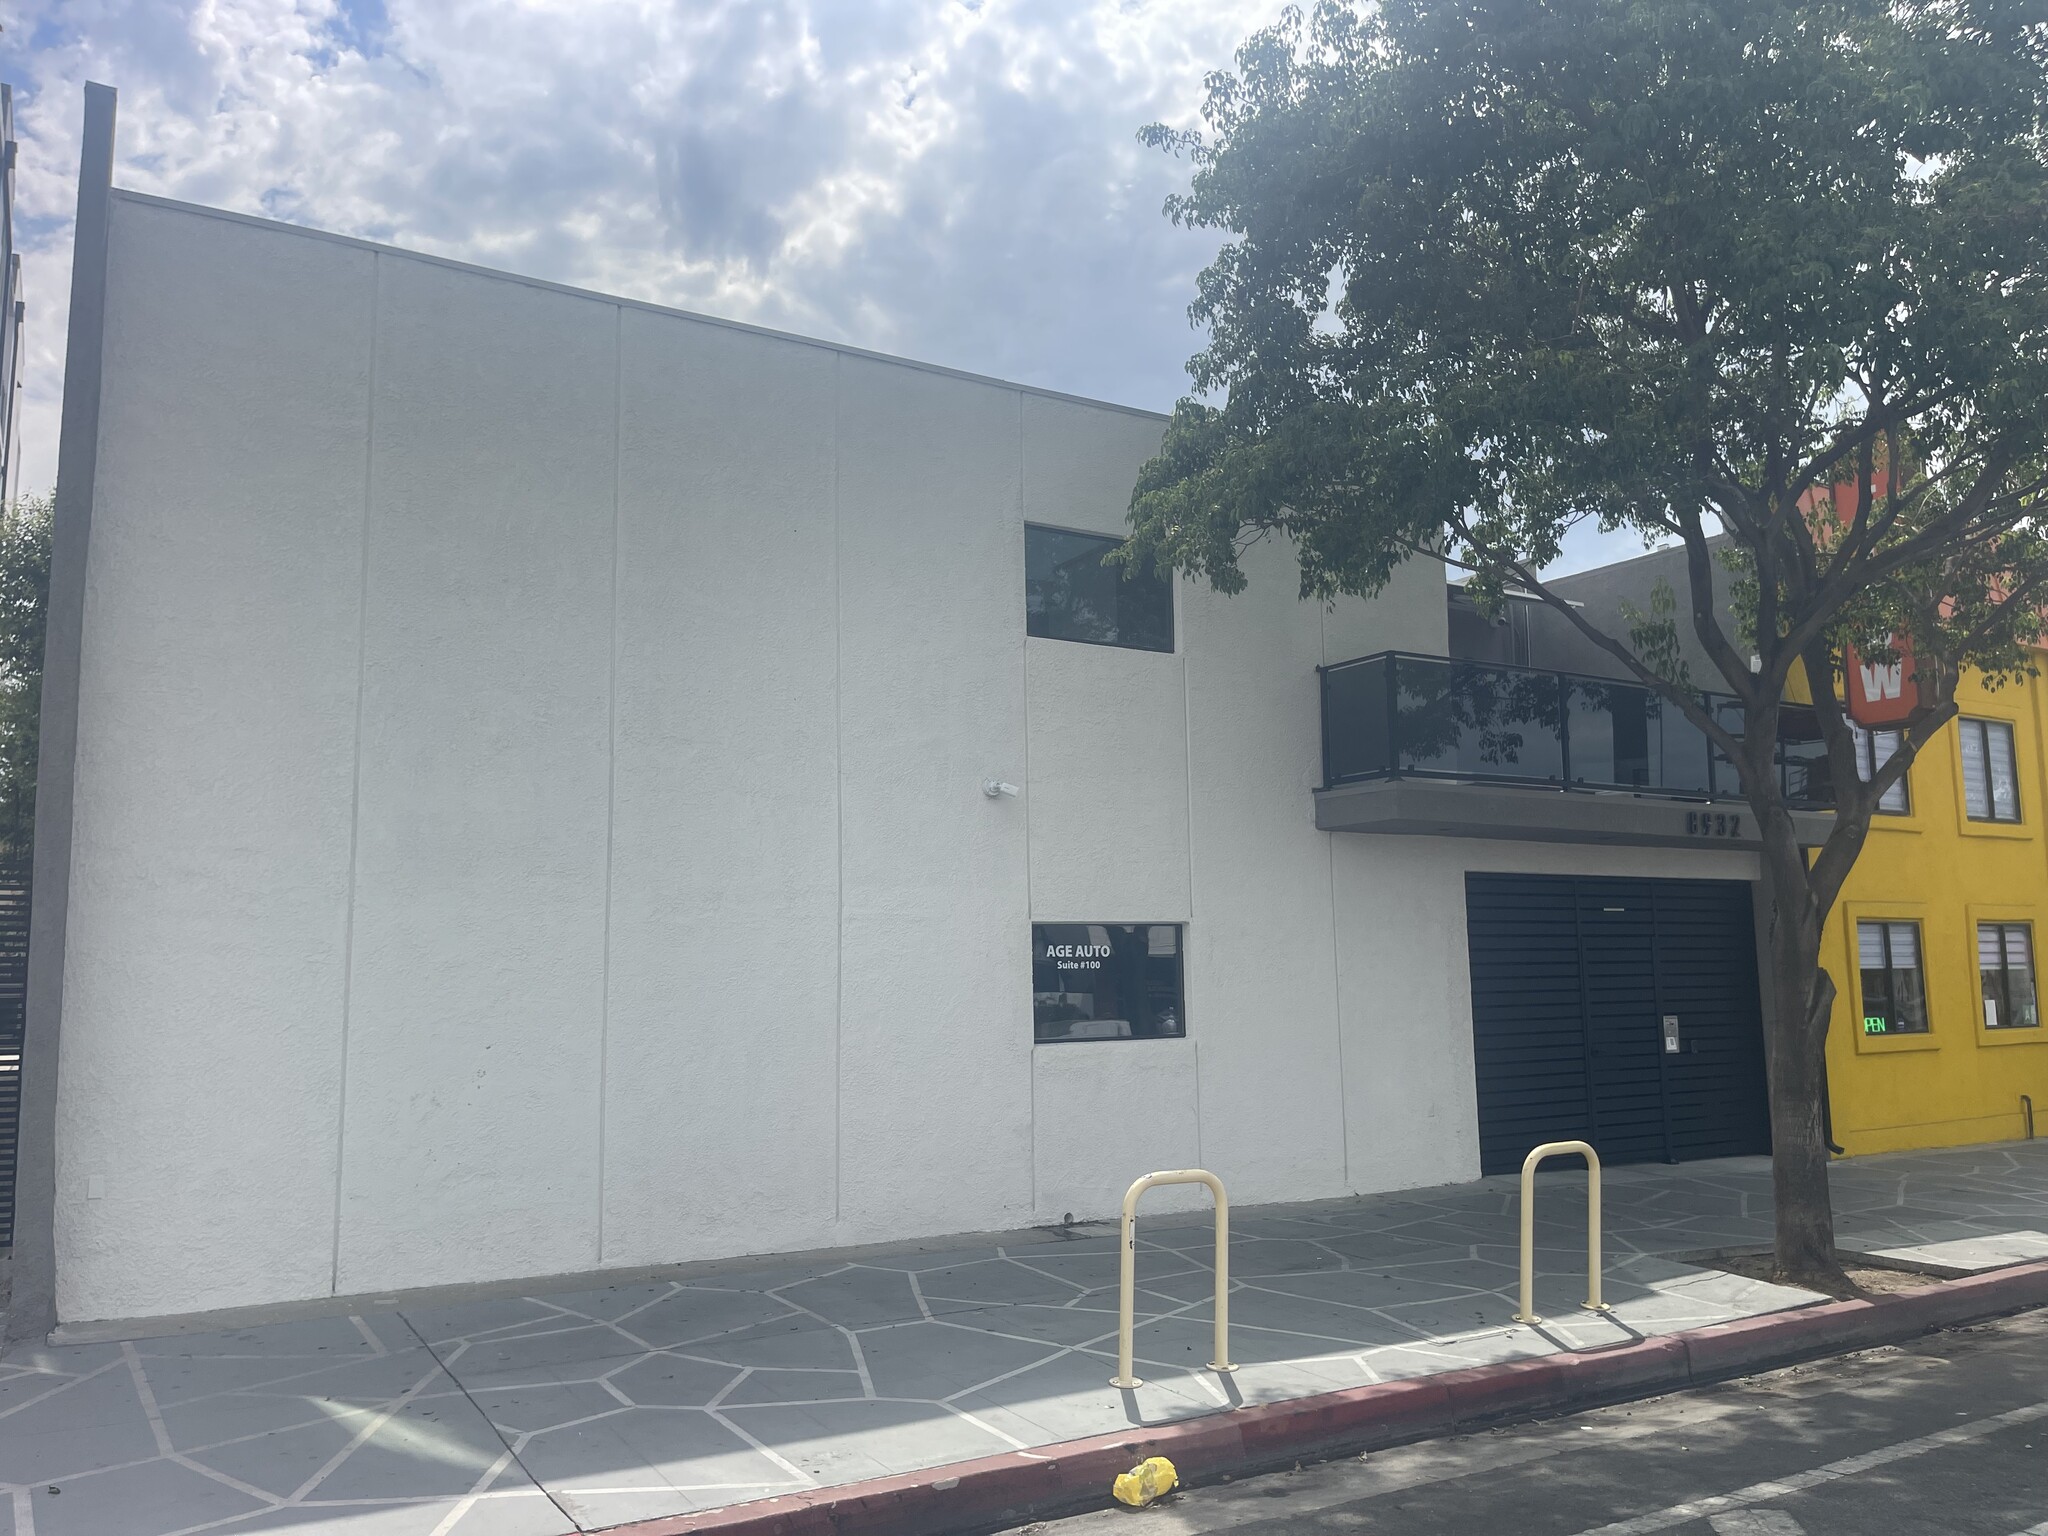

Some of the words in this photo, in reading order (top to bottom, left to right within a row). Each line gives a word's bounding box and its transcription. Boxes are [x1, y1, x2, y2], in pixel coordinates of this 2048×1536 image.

[1046, 945, 1073, 958] AGE
[1075, 945, 1111, 958] AUTO
[1057, 960, 1079, 970] Suite
[1080, 960, 1101, 970] #100
[1863, 1016, 1886, 1033] PEN
